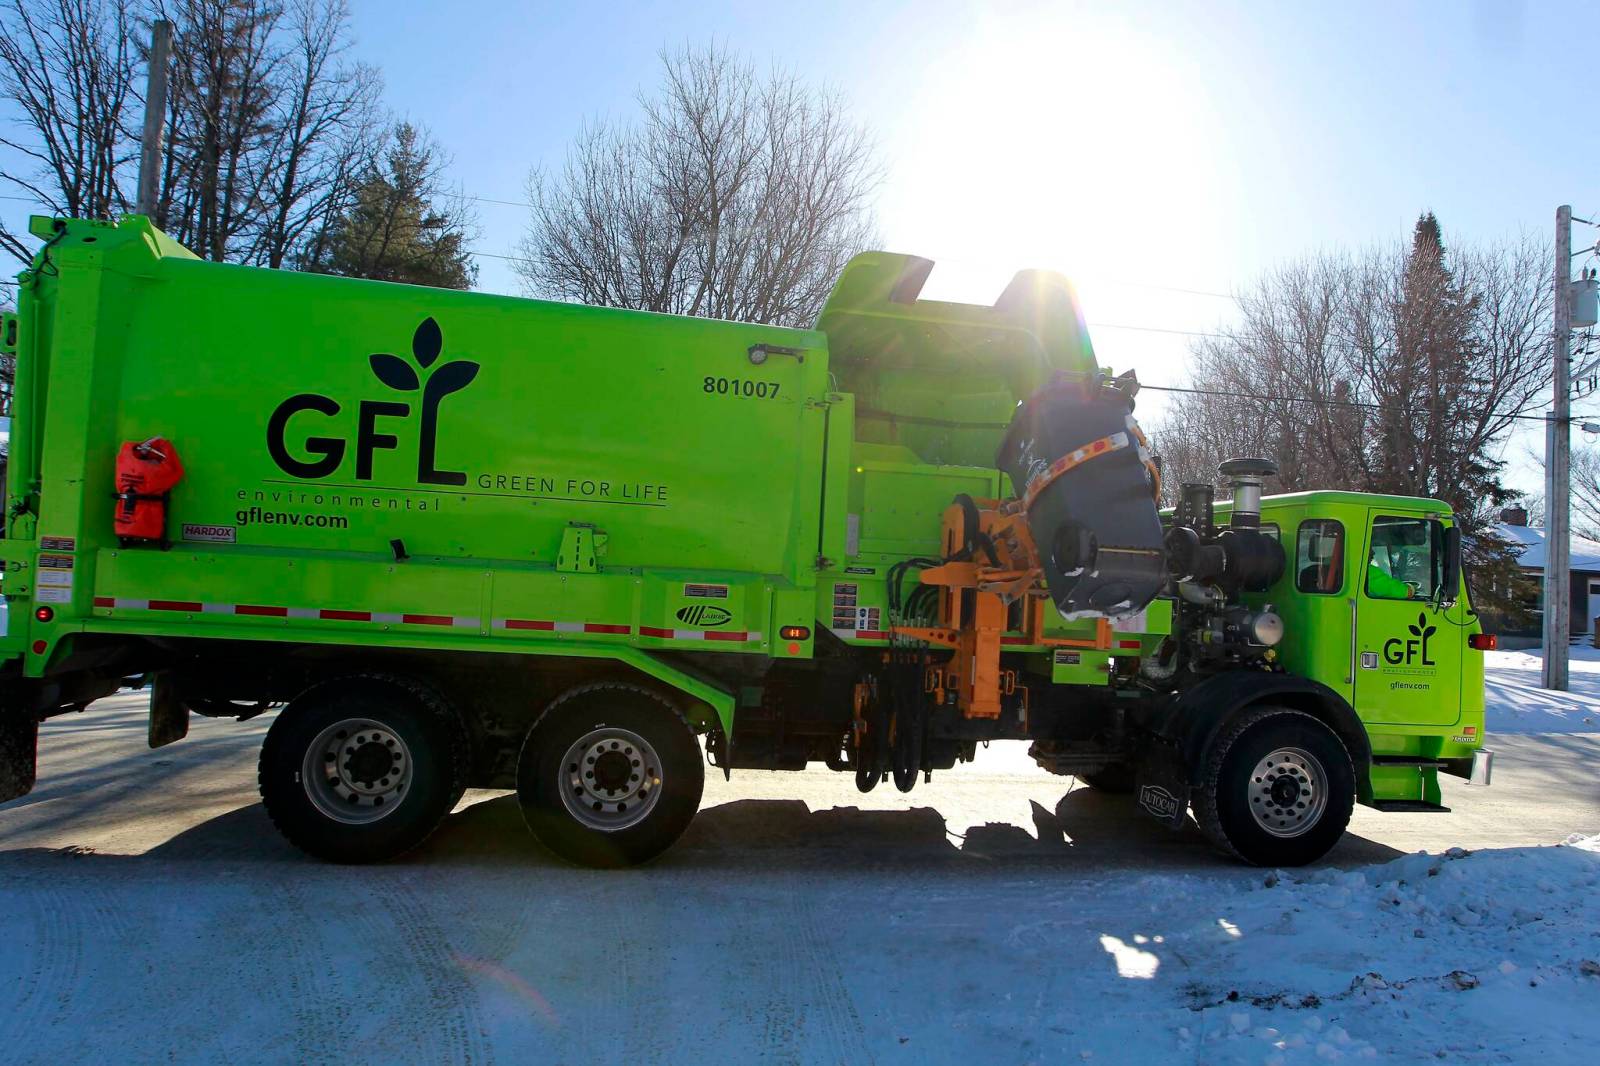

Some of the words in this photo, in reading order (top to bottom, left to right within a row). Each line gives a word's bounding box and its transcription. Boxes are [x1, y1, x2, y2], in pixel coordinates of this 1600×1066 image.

[703, 376, 780, 399] 801007
[267, 361, 480, 487] GFL
[478, 474, 555, 493] GREEN
[567, 479, 611, 496] FOR
[623, 483, 668, 500] LIFE
[237, 489, 440, 511] environmental
[236, 507, 349, 528] gflenv.com
[184, 526, 232, 537] HARDOX
[1383, 626, 1437, 666] GFL
[1390, 681, 1430, 690] gflenv.com
